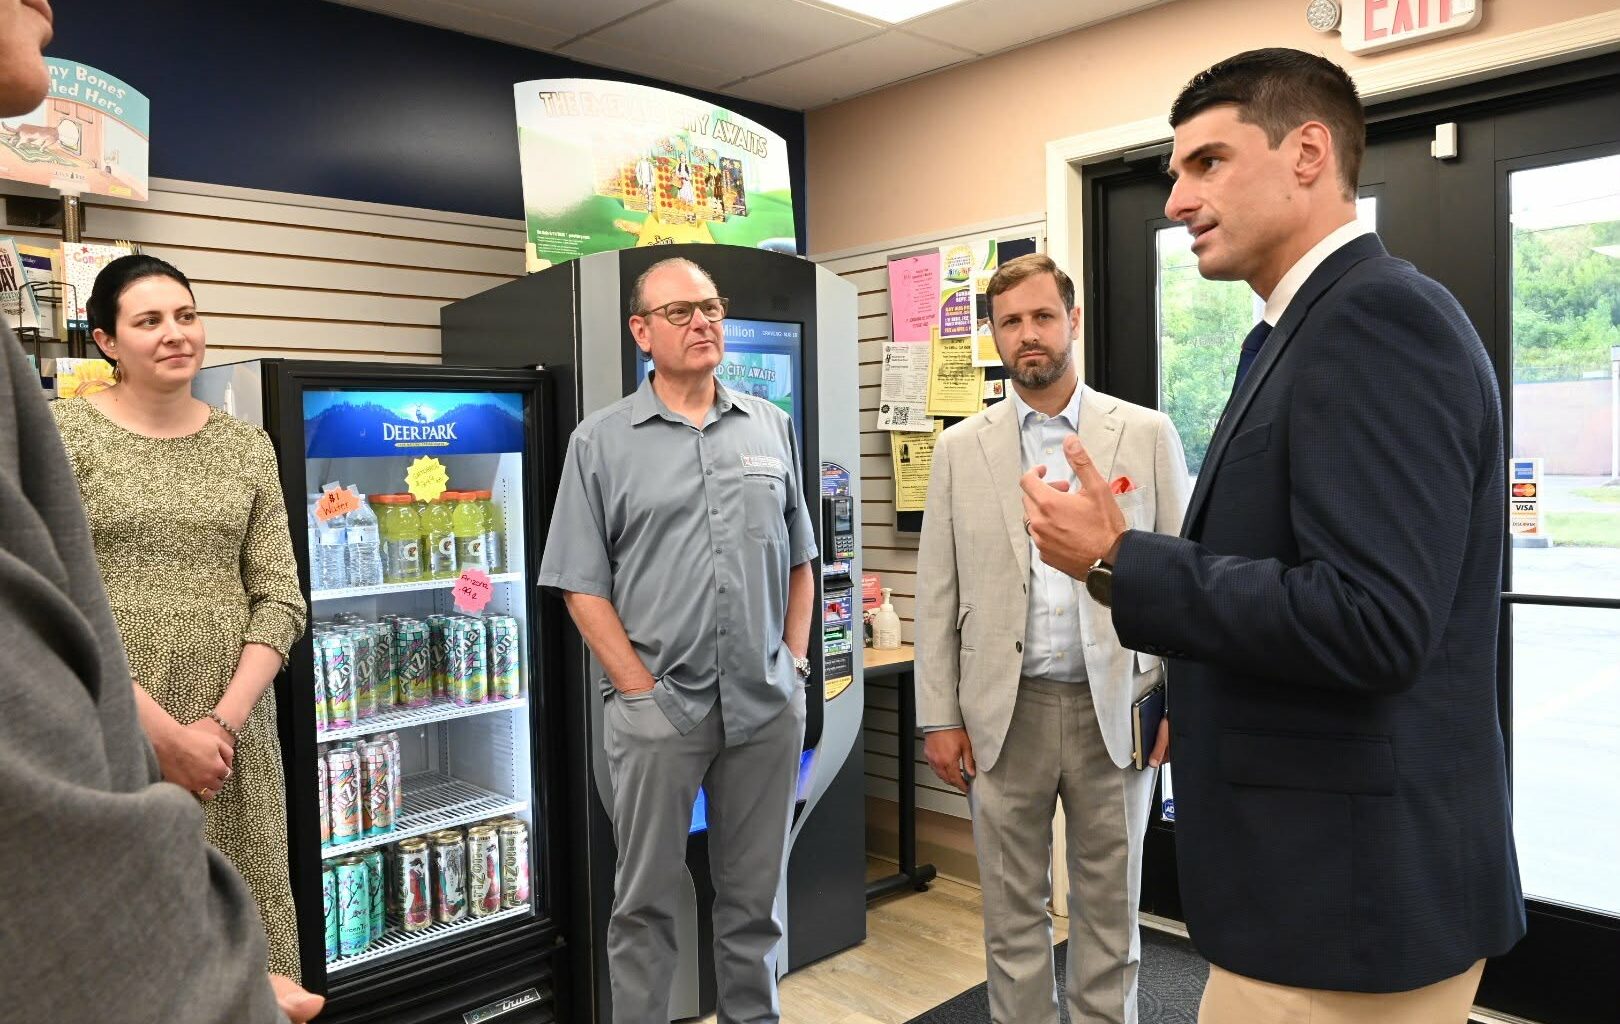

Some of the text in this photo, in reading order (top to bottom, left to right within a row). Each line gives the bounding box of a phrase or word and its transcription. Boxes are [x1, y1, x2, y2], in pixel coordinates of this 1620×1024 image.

[48, 65, 126, 99] ny Bones
[48, 78, 124, 115] led Here
[712, 119, 768, 159] AWAITS
[727, 365, 746, 376] CITY
[748, 367, 776, 382] AWAITS
[382, 422, 458, 440] DEER PARK
